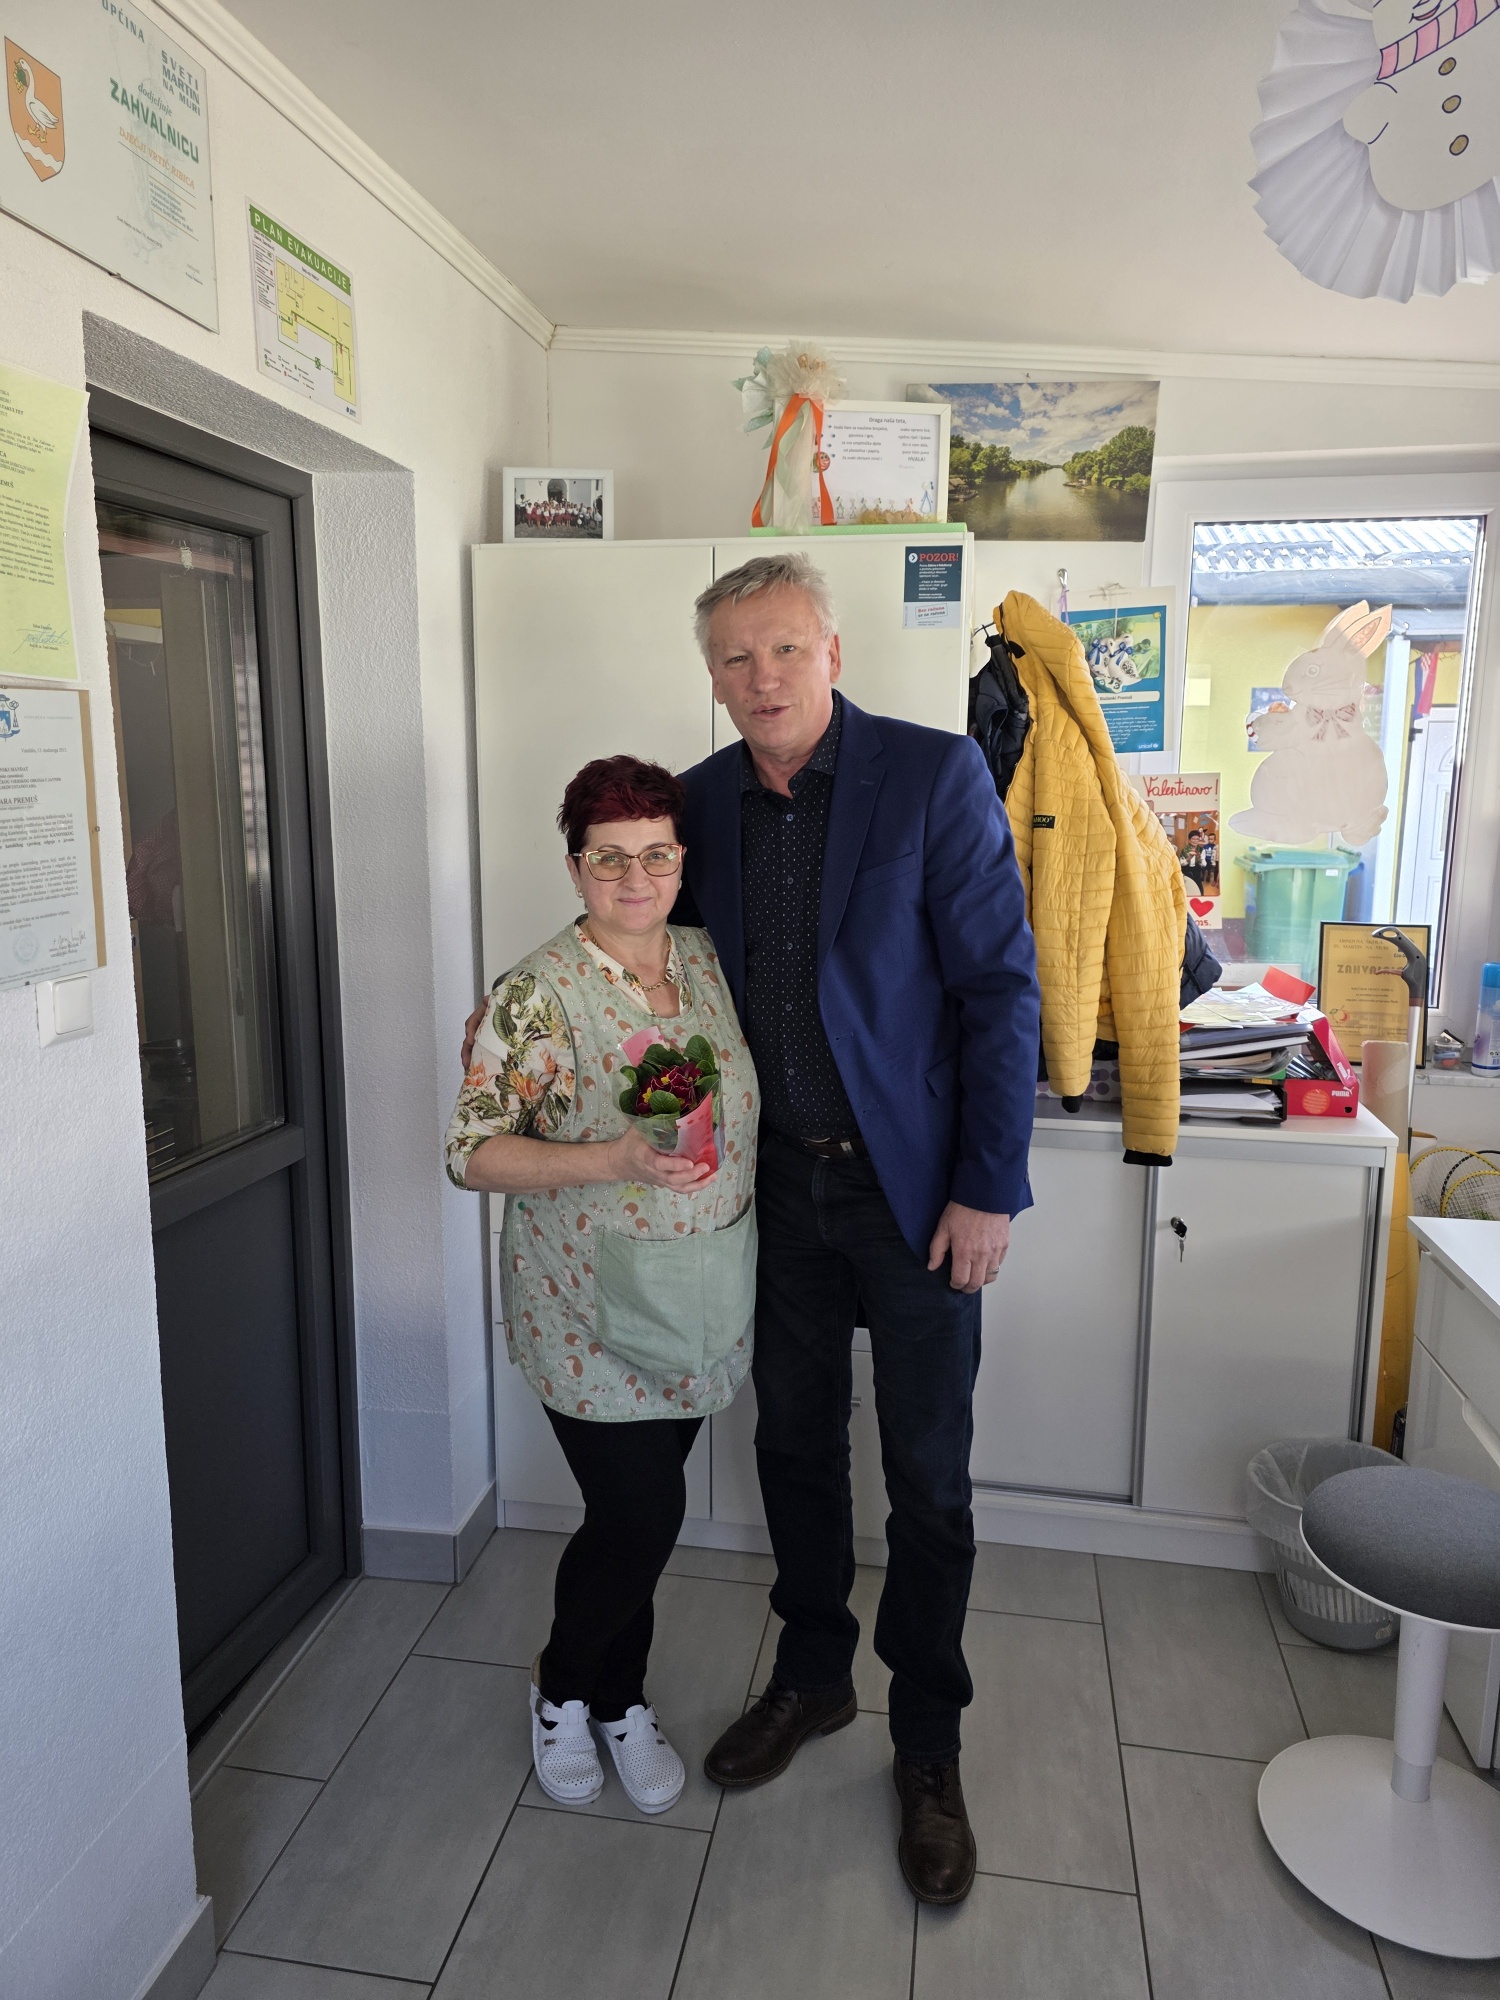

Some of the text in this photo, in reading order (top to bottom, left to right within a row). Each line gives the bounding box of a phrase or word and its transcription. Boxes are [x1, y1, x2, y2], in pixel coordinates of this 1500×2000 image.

[162, 49, 199, 91] SVETI
[162, 64, 200, 105] MARTIN
[138, 82, 173, 117] dodjeljuje
[163, 78, 201, 116] NA MURI
[109, 77, 200, 165] ZAHVALNICU
[171, 165, 195, 190] RIBICA
[254, 212, 284, 243] PLAN
[287, 236, 348, 290] EVAKUACIJE
[919, 552, 959, 562] POZOR!
[1143, 776, 1213, 798] Valentinovo
[1194, 919, 1212, 927] 025.
